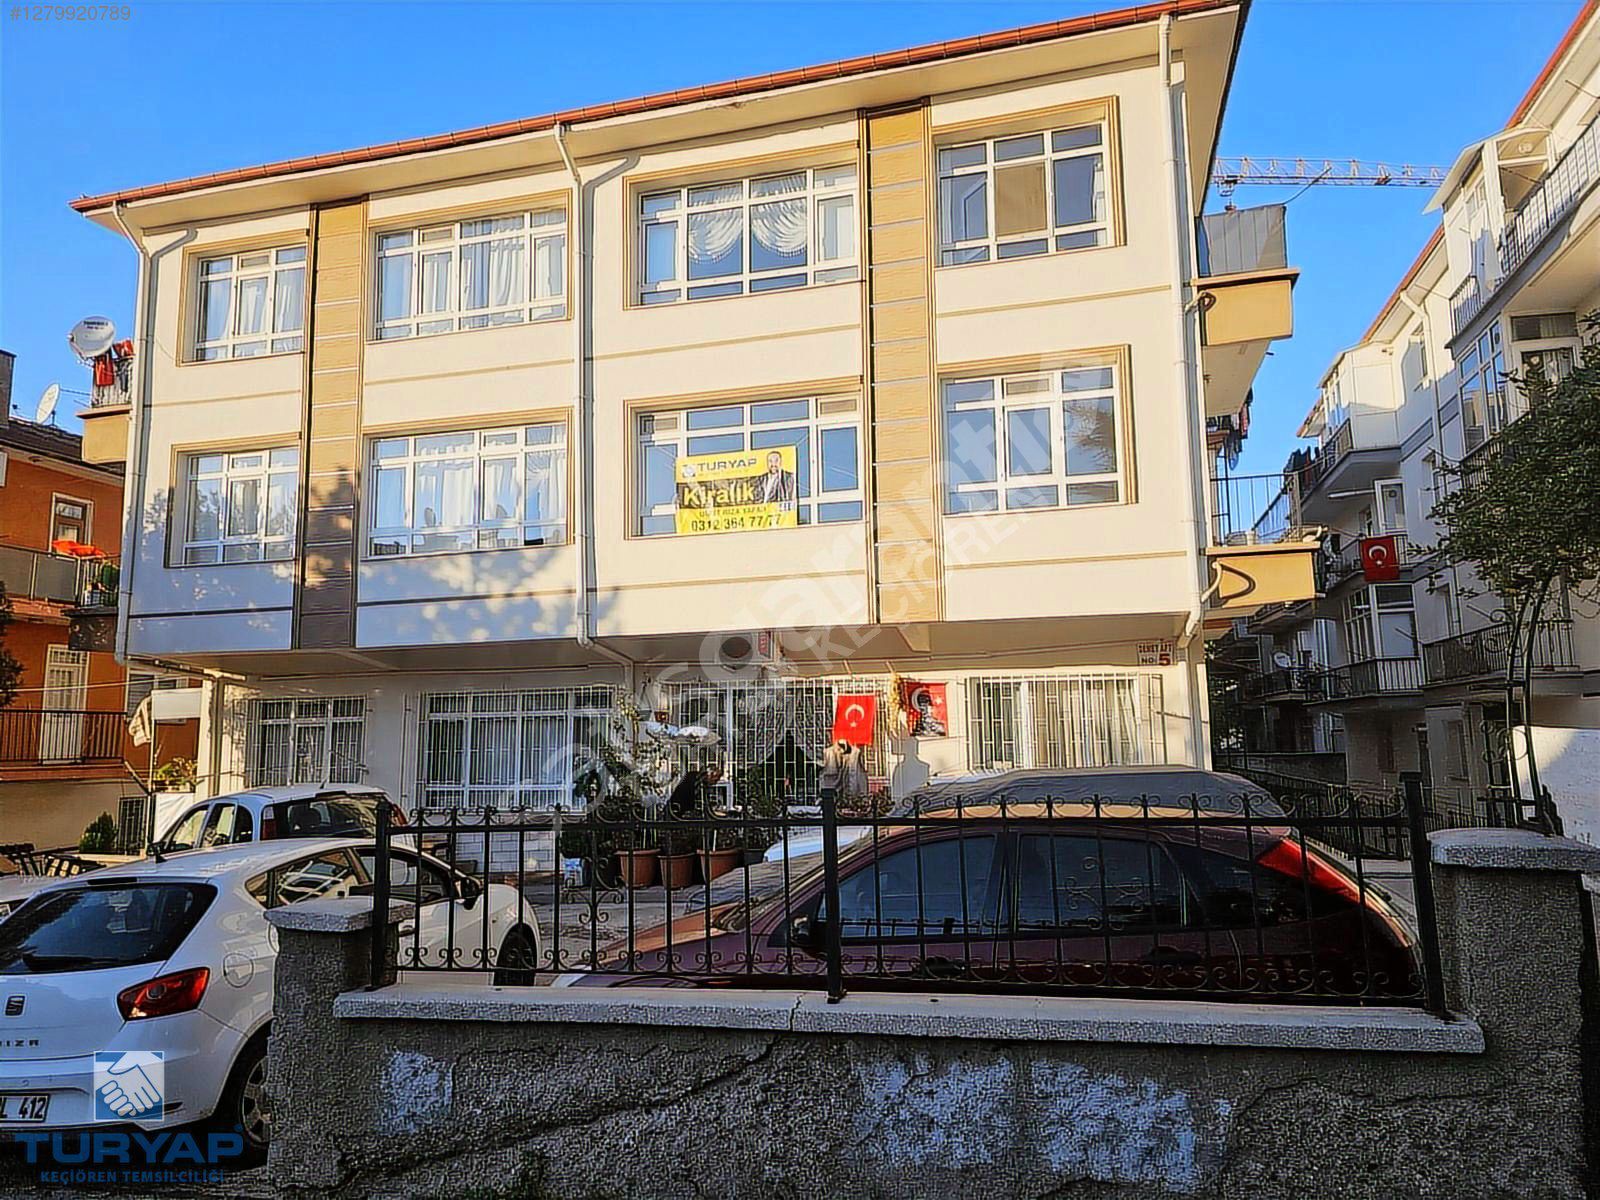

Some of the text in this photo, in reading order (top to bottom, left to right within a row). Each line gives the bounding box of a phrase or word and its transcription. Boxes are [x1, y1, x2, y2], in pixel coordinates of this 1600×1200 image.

[698, 458, 757, 472] TURYAP
[1159, 653, 1171, 666] 5
[18, 1096, 47, 1119] 412
